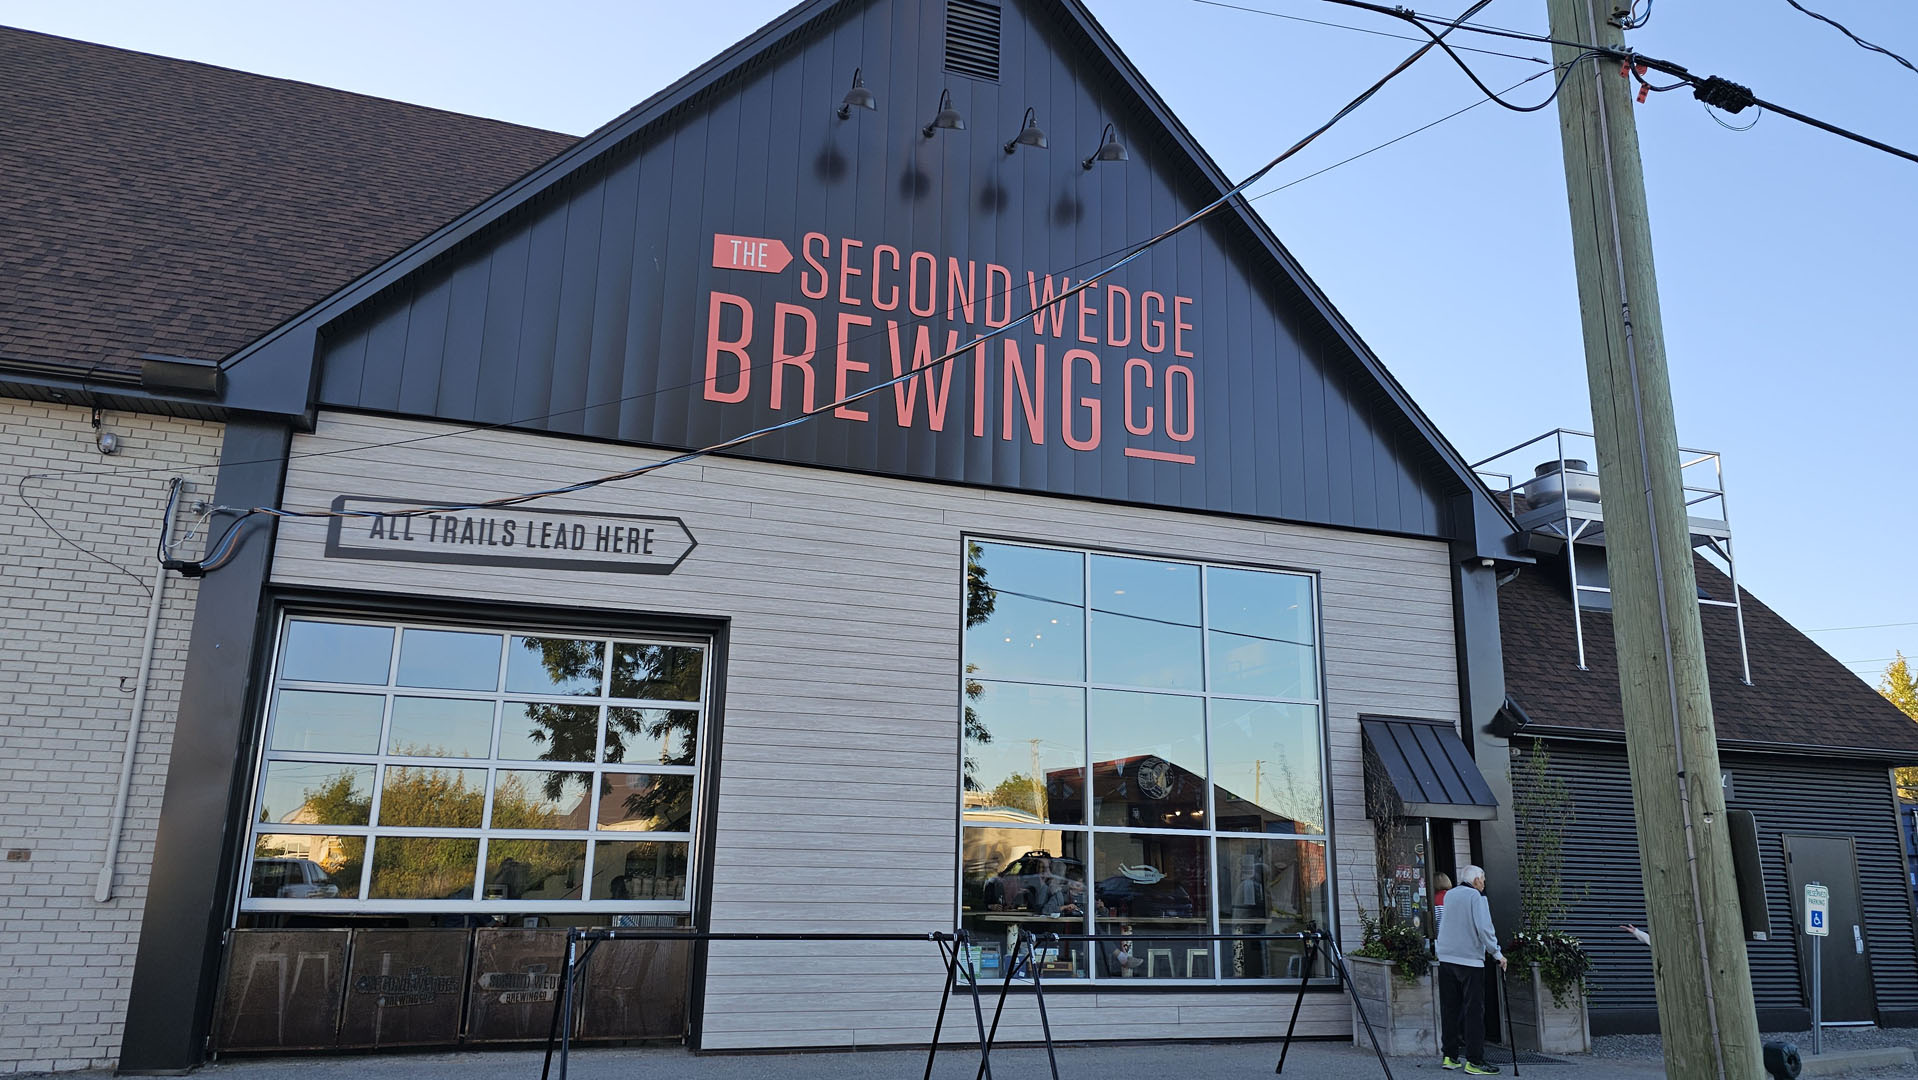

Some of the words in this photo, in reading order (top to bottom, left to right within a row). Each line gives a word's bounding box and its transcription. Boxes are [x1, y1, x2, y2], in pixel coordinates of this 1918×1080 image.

[730, 240, 768, 269] THE
[801, 231, 1012, 329] SECOND
[1027, 271, 1194, 358] WEDGE
[704, 291, 1102, 451] BREWING
[1124, 358, 1196, 442] CO
[369, 514, 414, 541] ALL
[428, 514, 517, 547] TRAILS
[526, 520, 586, 551] LEAD
[595, 525, 655, 555] HERE
